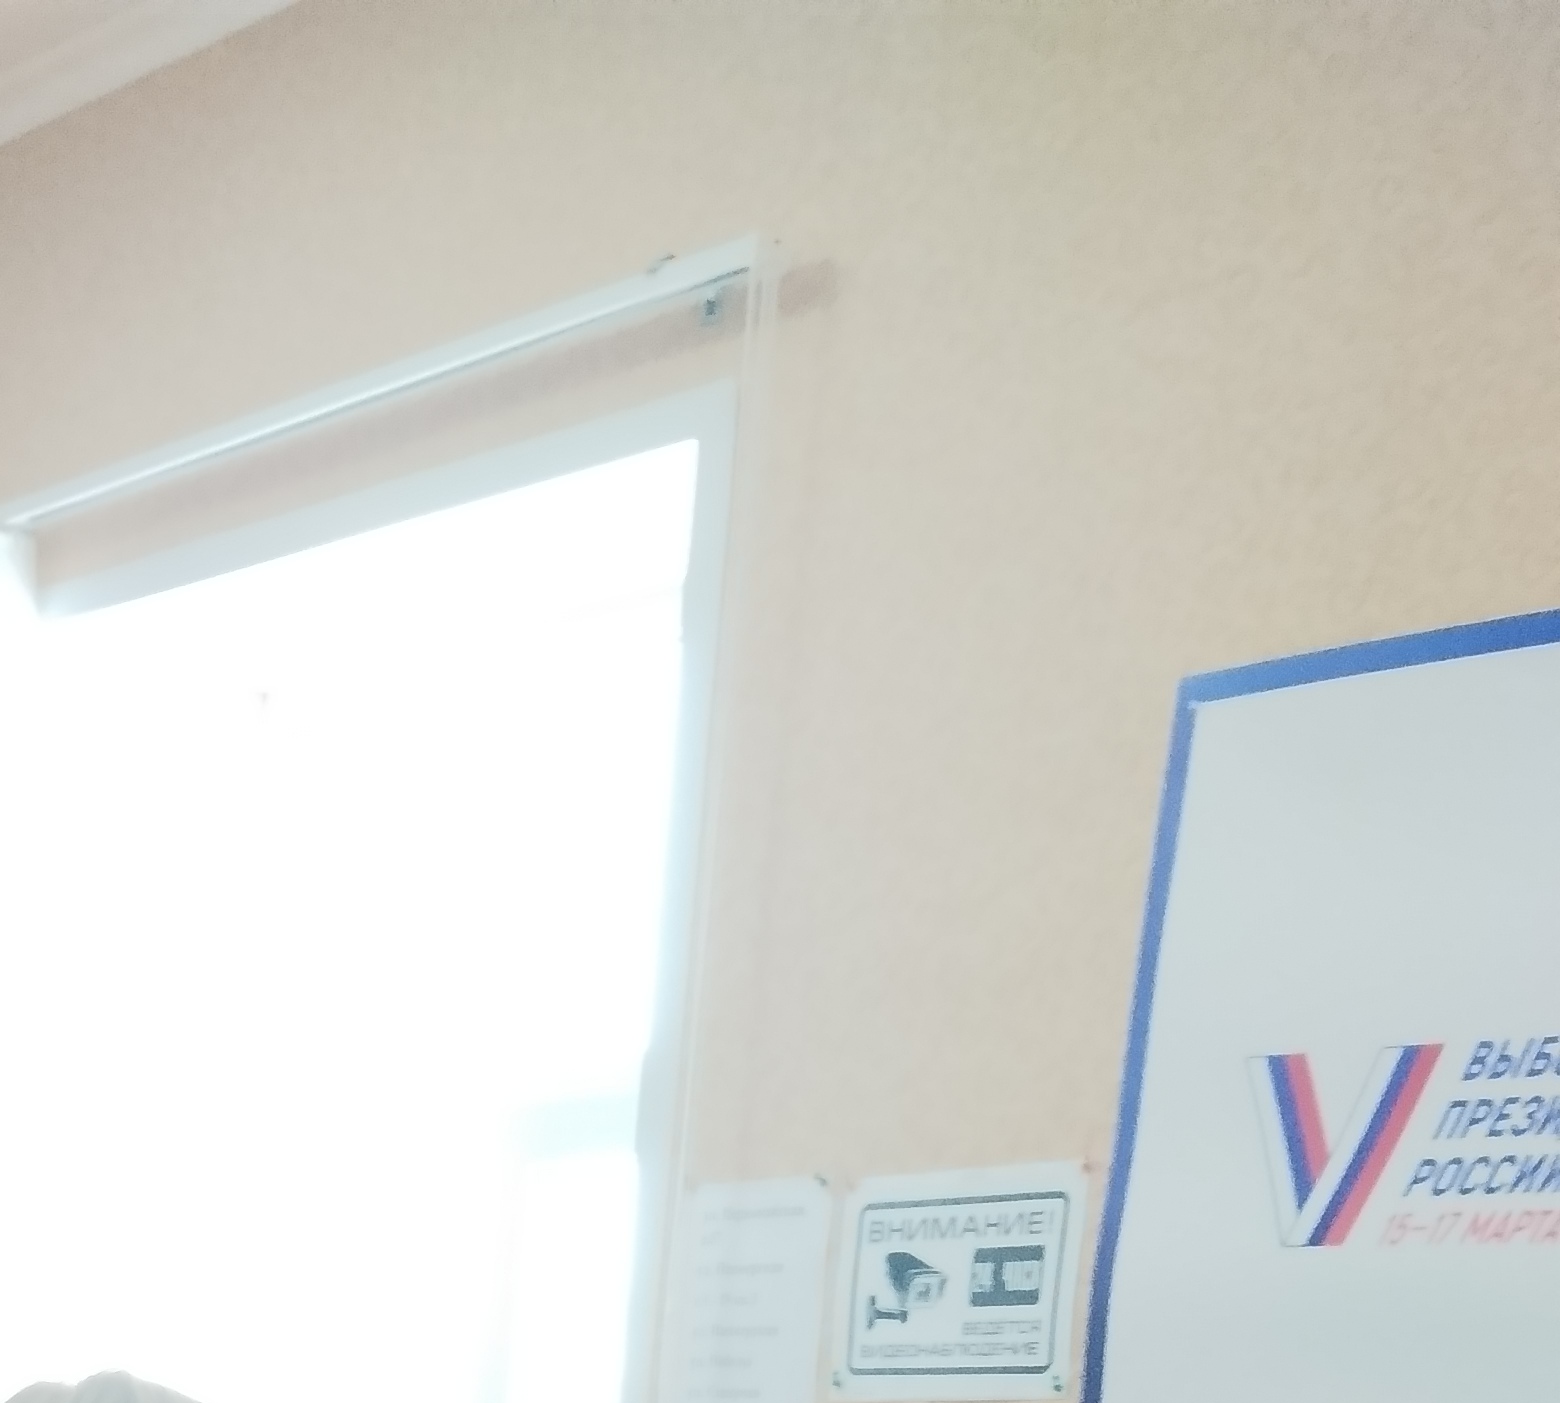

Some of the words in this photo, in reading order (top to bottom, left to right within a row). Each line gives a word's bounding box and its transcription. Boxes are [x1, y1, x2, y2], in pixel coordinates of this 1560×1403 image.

[868, 1209, 1055, 1243] ВНИМАНИЕ!
[961, 1319, 1042, 1337] ВЕДЕТСЯ
[860, 1341, 1040, 1358] ВИДЕОНАБЛЮДЕНИЕ
